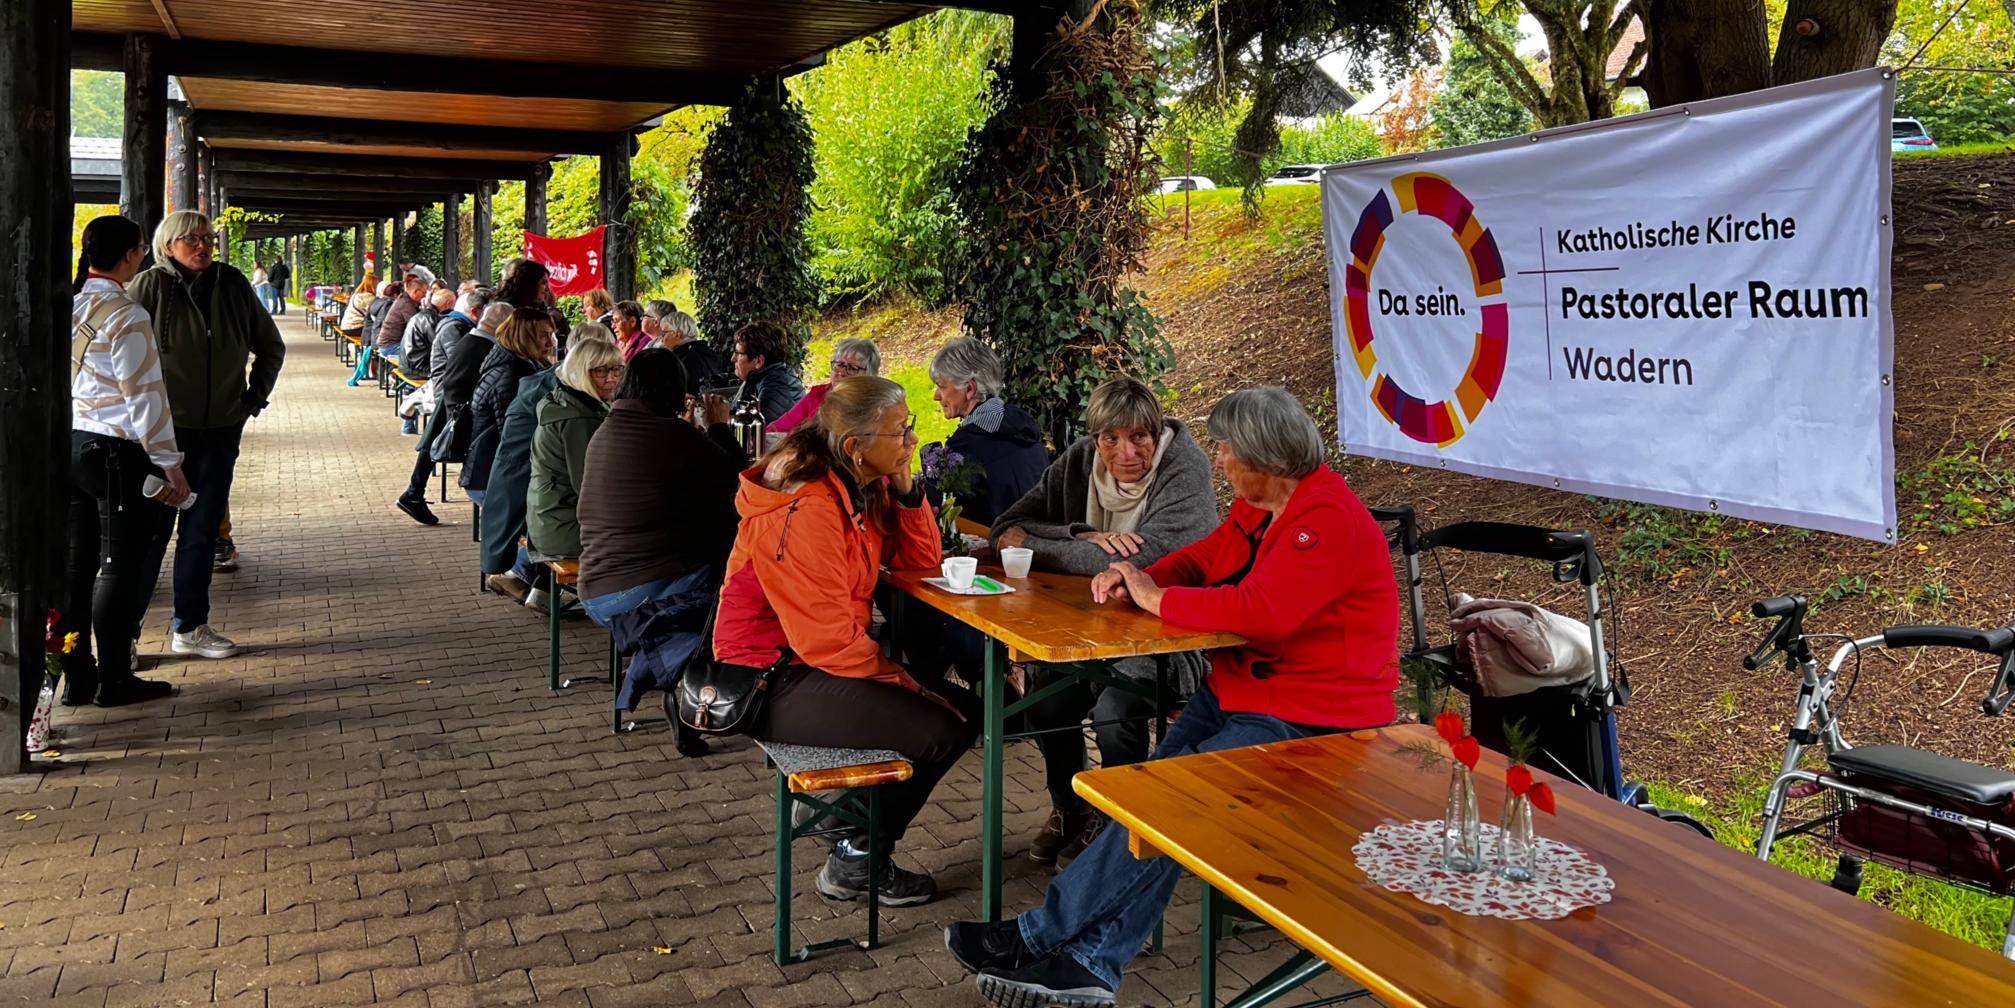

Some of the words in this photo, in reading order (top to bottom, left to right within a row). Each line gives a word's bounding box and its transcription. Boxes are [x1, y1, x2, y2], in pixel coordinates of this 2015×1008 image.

[1558, 221, 1699, 253] Katholische
[1707, 213, 1795, 244] Kirche
[1379, 289, 1409, 315] Da
[1415, 286, 1465, 315] sein.
[1562, 283, 1738, 319] Pastoraler
[1748, 281, 1867, 318] Raum
[1563, 347, 1692, 385] Wadern
